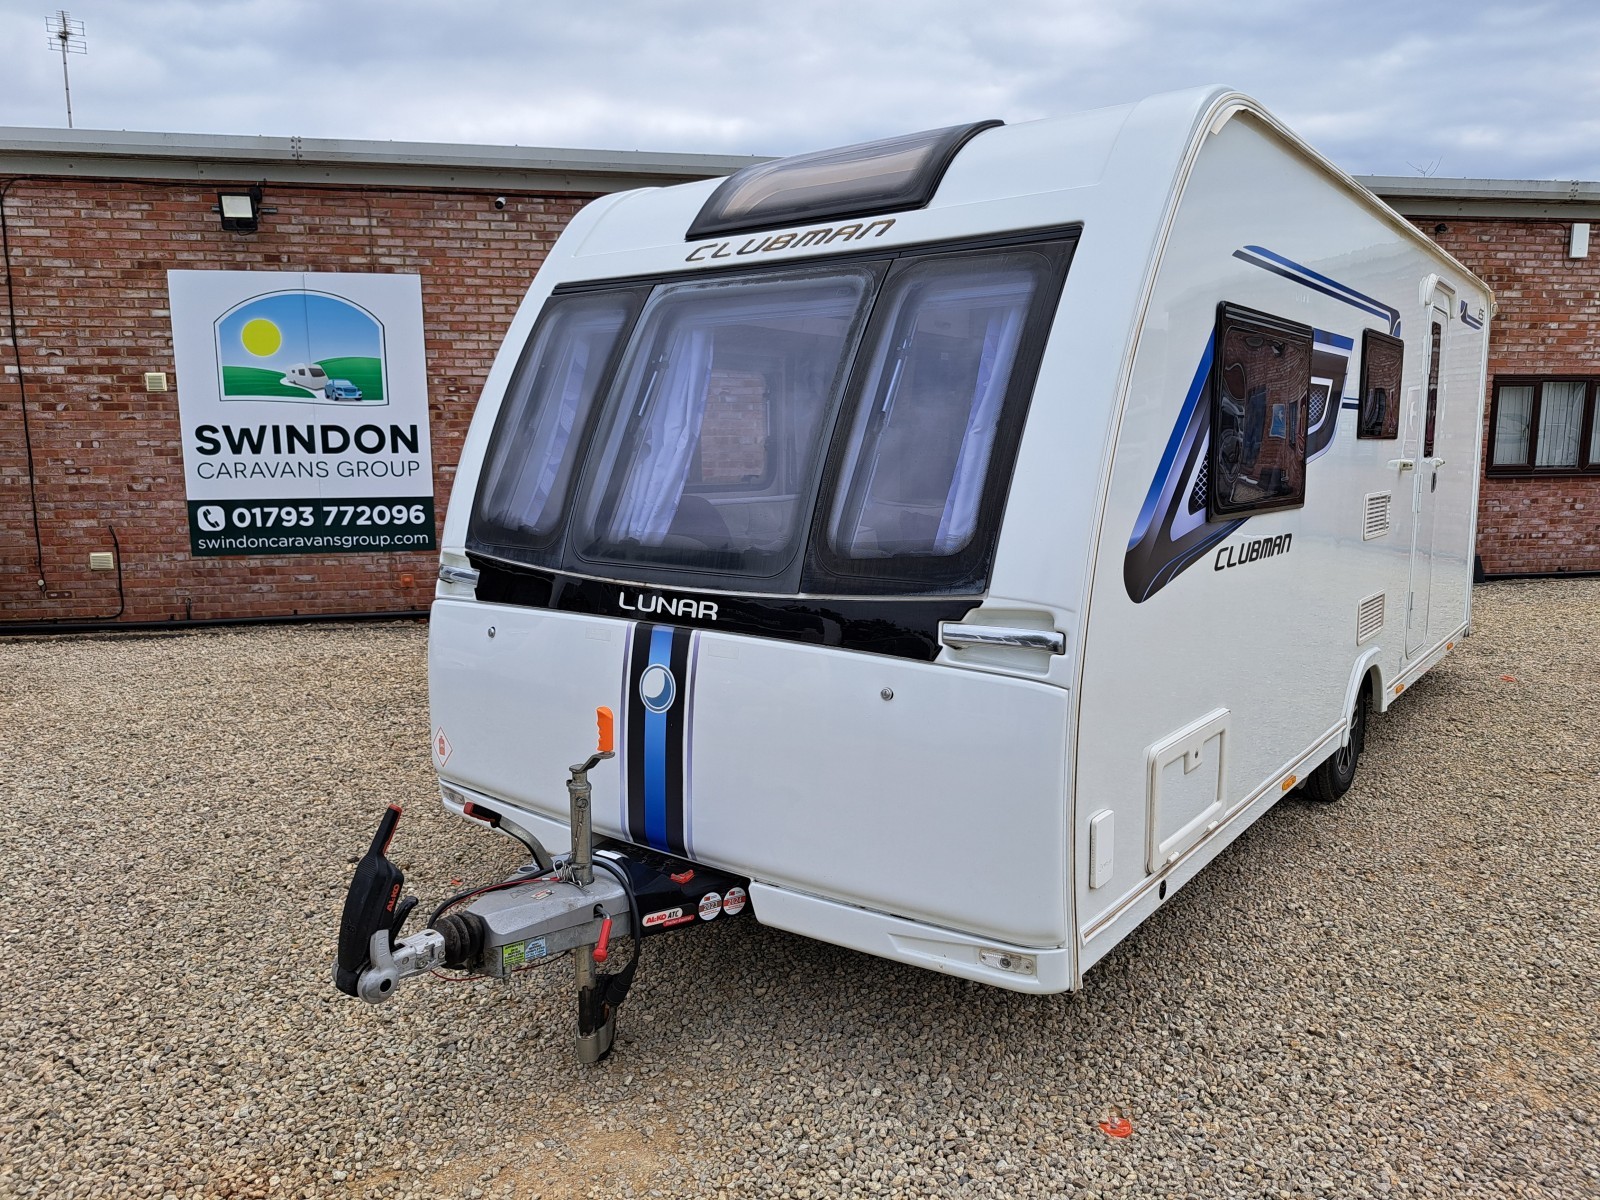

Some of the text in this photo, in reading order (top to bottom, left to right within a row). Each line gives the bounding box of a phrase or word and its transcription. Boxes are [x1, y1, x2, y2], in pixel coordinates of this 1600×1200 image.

[685, 218, 897, 262] CLUBMAN
[194, 424, 419, 456] SWINDON
[196, 460, 420, 480] CARAVANS GROUP
[232, 504, 426, 528] 01793 772096
[198, 533, 429, 550] swindoncaravansgroup.com
[1214, 533, 1293, 571] CLUBMAN
[618, 591, 719, 621] LUNAR
[667, 909, 680, 919] ATC
